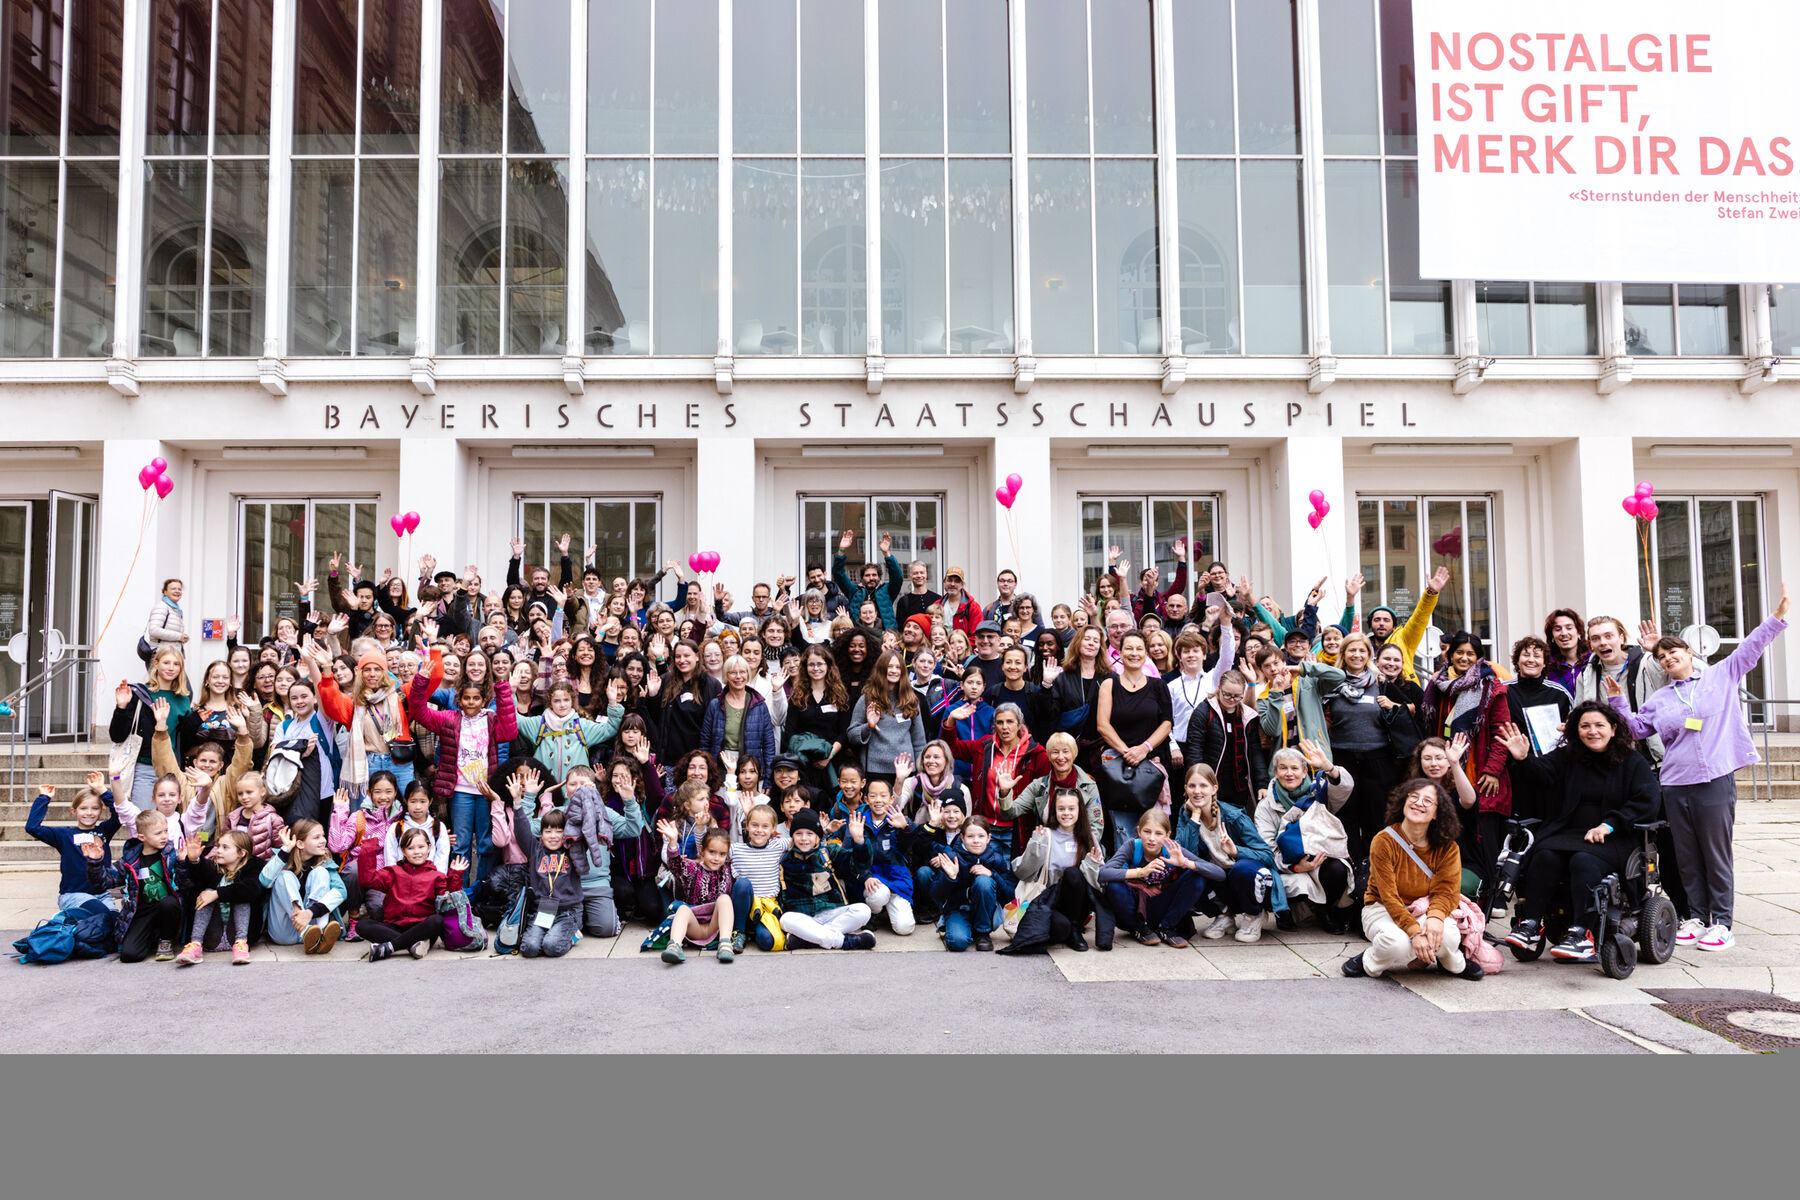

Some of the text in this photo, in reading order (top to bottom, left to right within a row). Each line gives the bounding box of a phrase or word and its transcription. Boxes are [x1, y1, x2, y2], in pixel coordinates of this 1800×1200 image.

[1431, 32, 1712, 72] NOSTALGIE
[1432, 83, 1649, 131] IST GIFT,
[1434, 134, 1576, 174] MERK
[1595, 136, 1679, 175] DIR
[1569, 190, 1800, 203] «Sternstunden der Menschheit
[1718, 207, 1763, 218] Stefan
[326, 403, 1415, 428] BAYERISCHES STAATSSCHAUSPIEL
